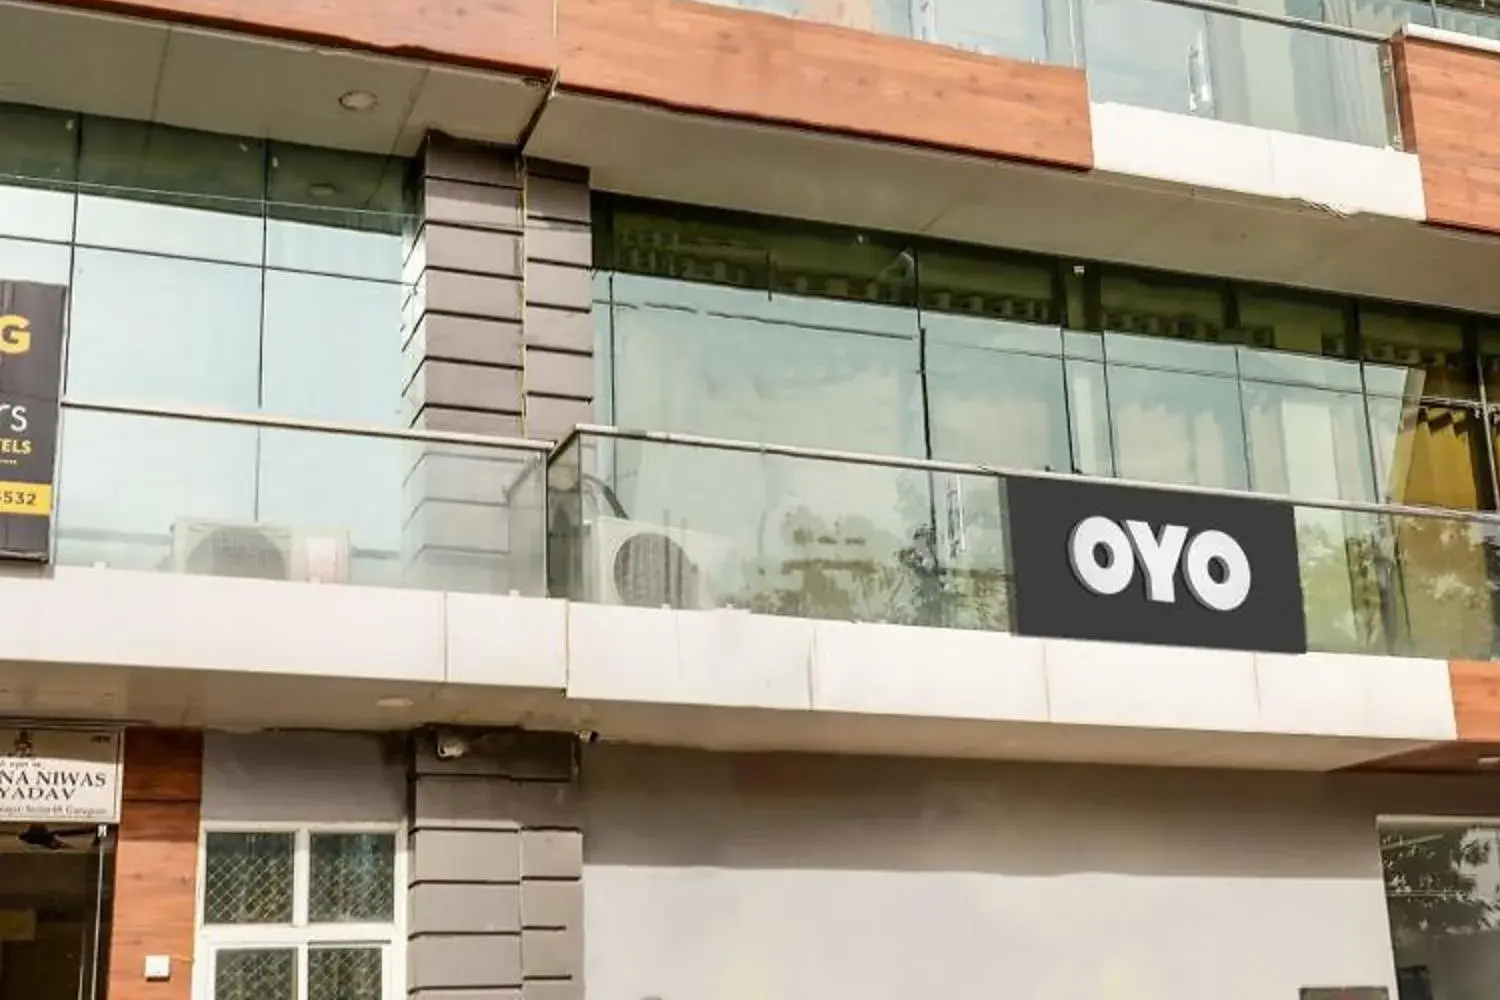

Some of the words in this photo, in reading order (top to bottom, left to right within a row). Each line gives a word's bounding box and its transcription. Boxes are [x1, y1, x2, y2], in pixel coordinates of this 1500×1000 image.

[0, 314, 31, 354] G
[0, 439, 32, 455] ELS
[1067, 515, 1251, 611] OYO
[36, 770, 106, 787] NIWAS
[0, 786, 76, 800] YADAV
